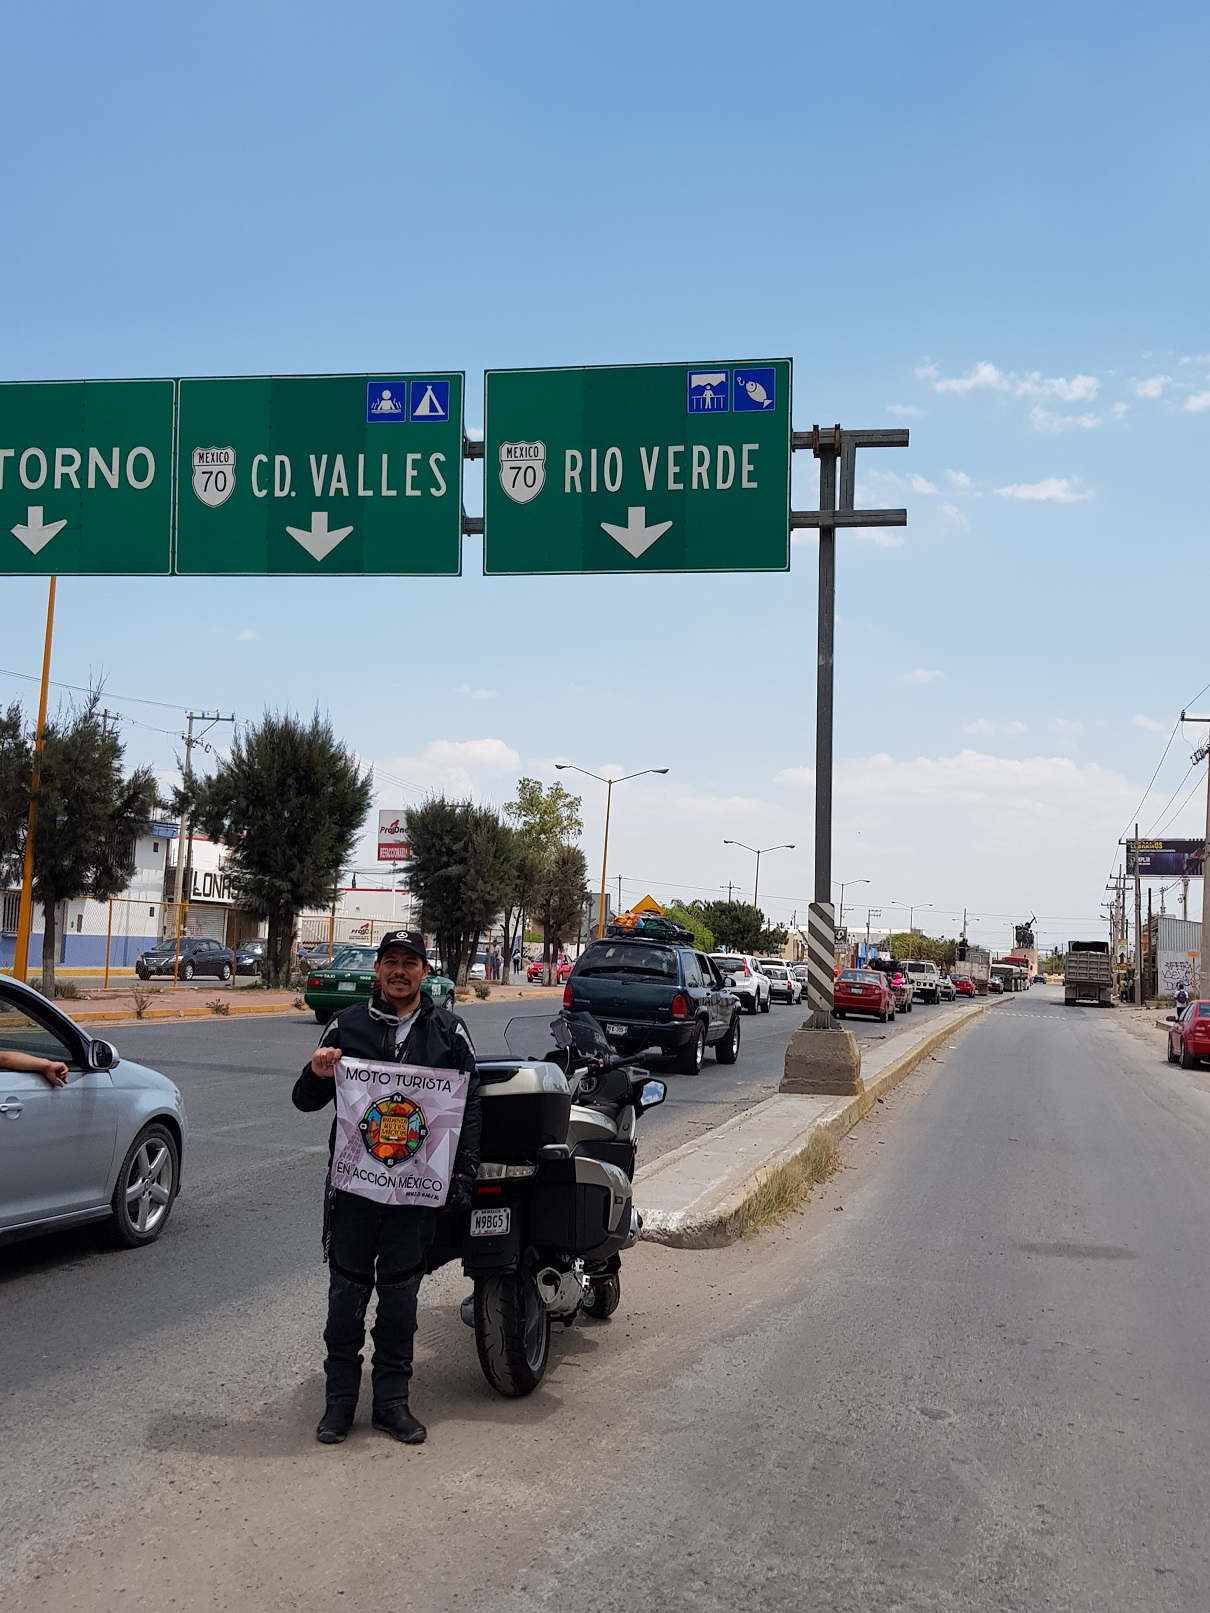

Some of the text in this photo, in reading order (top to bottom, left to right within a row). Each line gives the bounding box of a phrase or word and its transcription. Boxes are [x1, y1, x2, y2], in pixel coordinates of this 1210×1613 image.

[198, 451, 229, 464] MEXICO
[506, 446, 539, 460] MEXICO
[251, 452, 447, 498] CD. VALLES
[509, 465, 538, 489] 70
[564, 443, 760, 493] RIO VERDE
[201, 471, 227, 493] 70
[346, 1067, 452, 1092] MOTO TURISTA
[336, 1161, 443, 1192] EN ACCIÓN MÉXICO
